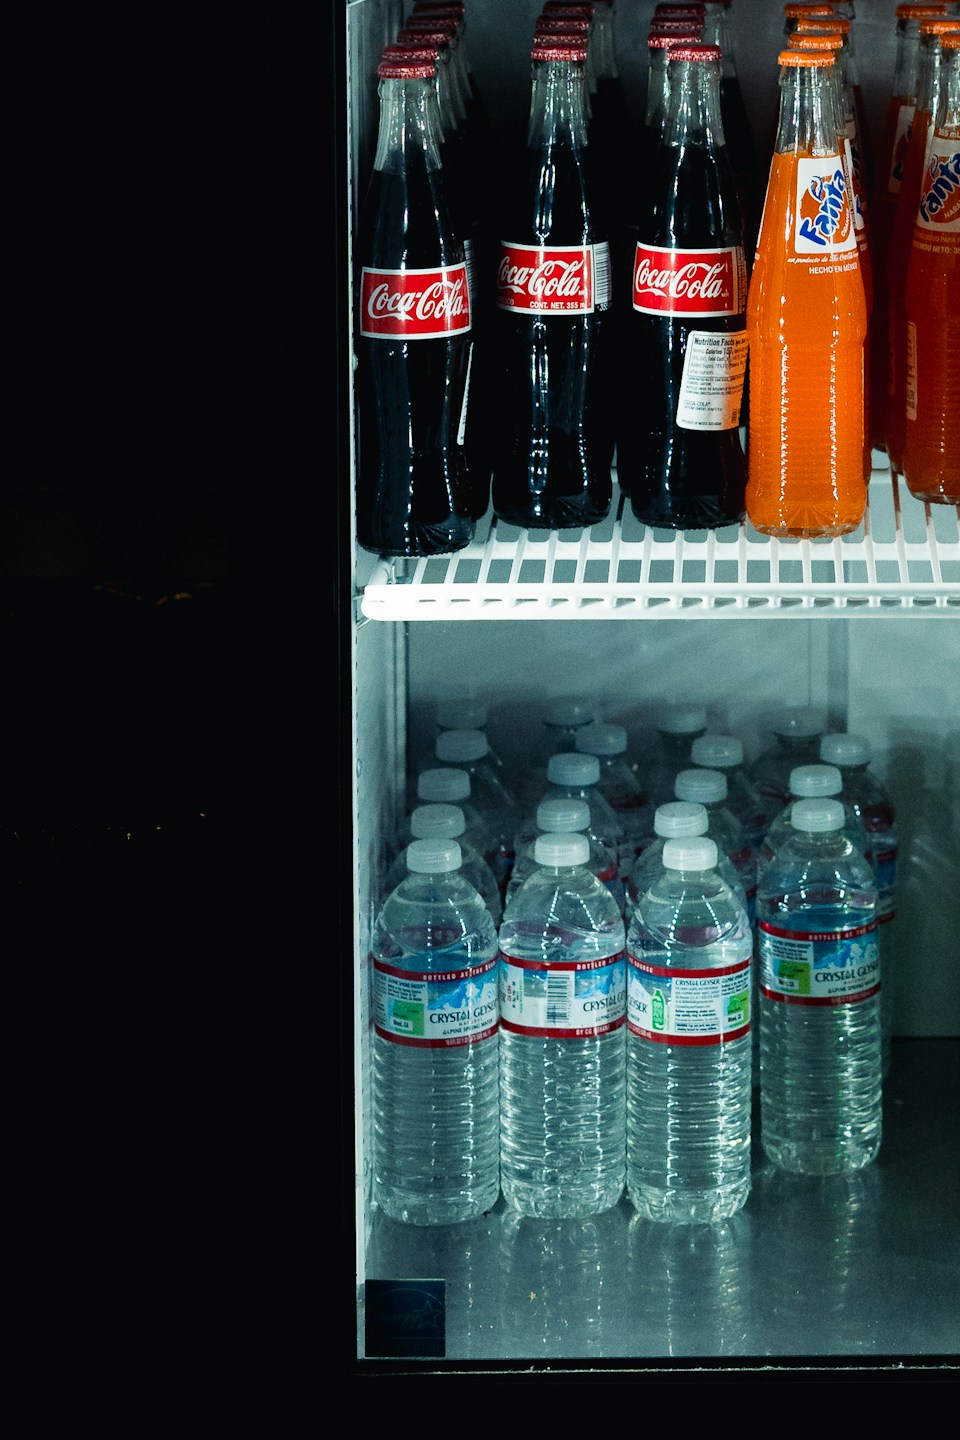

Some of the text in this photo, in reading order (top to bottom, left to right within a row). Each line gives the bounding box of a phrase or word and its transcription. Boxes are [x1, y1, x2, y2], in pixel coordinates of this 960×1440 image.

[799, 169, 846, 246] Fanta
[498, 255, 584, 297] Coca-Cola
[635, 257, 726, 299] Coca-Cola
[368, 277, 464, 321] Coca-Cola
[529, 301, 578, 309] CONT. NET. 355
[576, 961, 607, 971] BOTTLED
[815, 962, 880, 983] CRYSTAL GEYSE
[429, 998, 499, 1025] CRYSTAL GEYSE
[582, 999, 616, 1013] CRYSTAL
